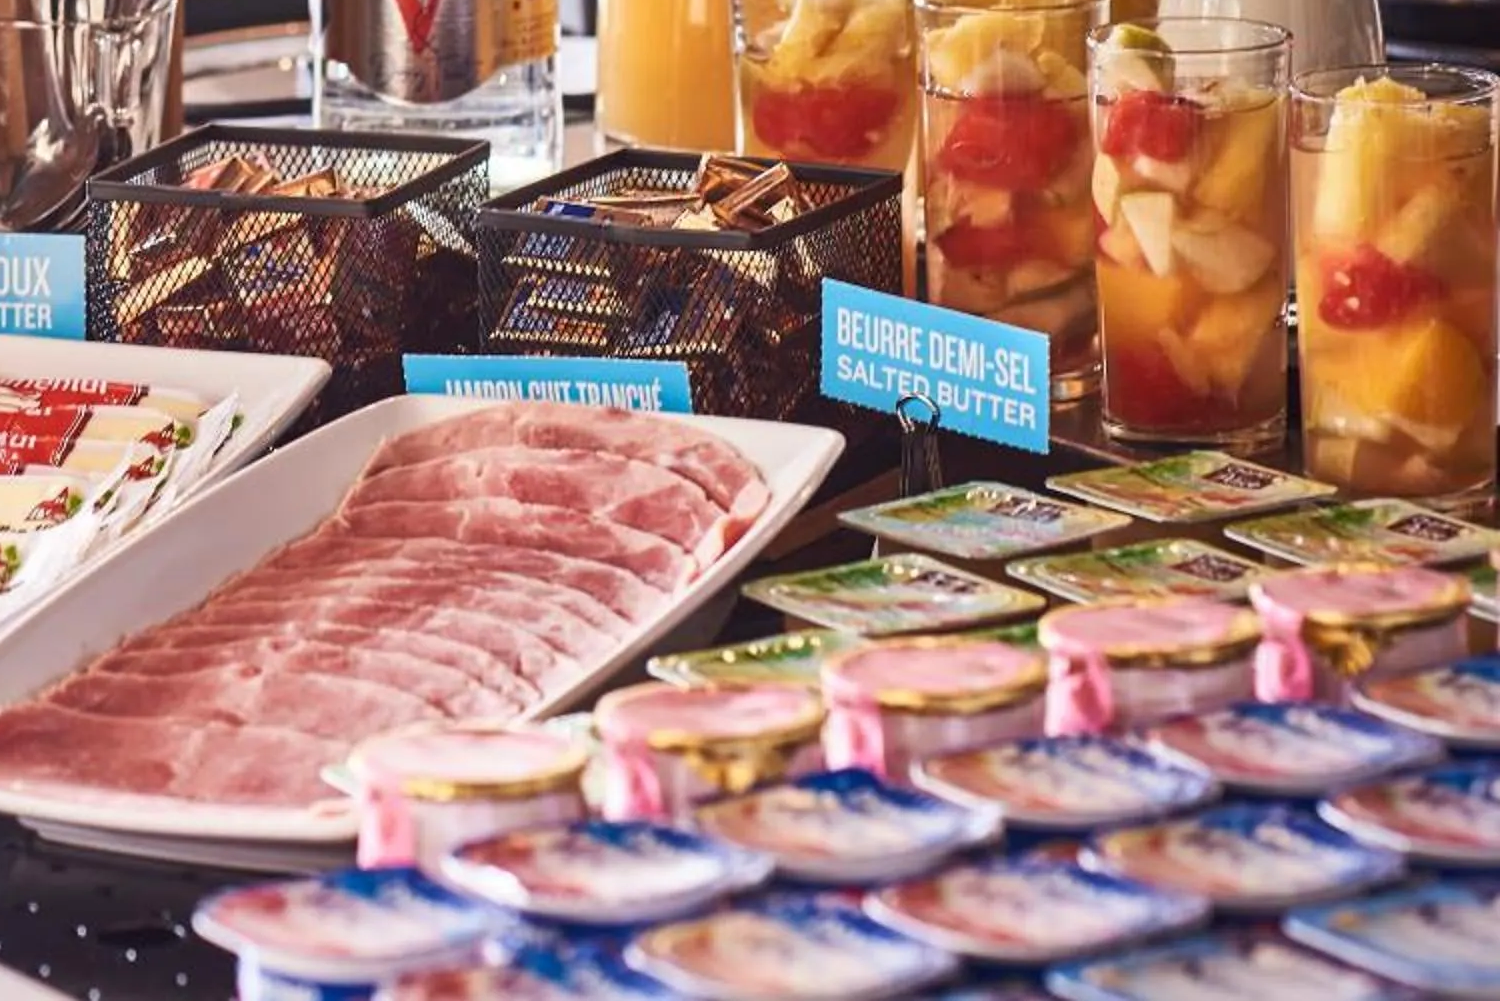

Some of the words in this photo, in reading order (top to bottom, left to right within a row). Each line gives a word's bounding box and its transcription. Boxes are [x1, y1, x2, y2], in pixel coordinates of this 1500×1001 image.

[836, 353, 930, 400] SALTED
[937, 380, 1037, 430] BUTTER
[837, 307, 923, 365] BEURRE
[929, 331, 1037, 395] DEMI-SEL
